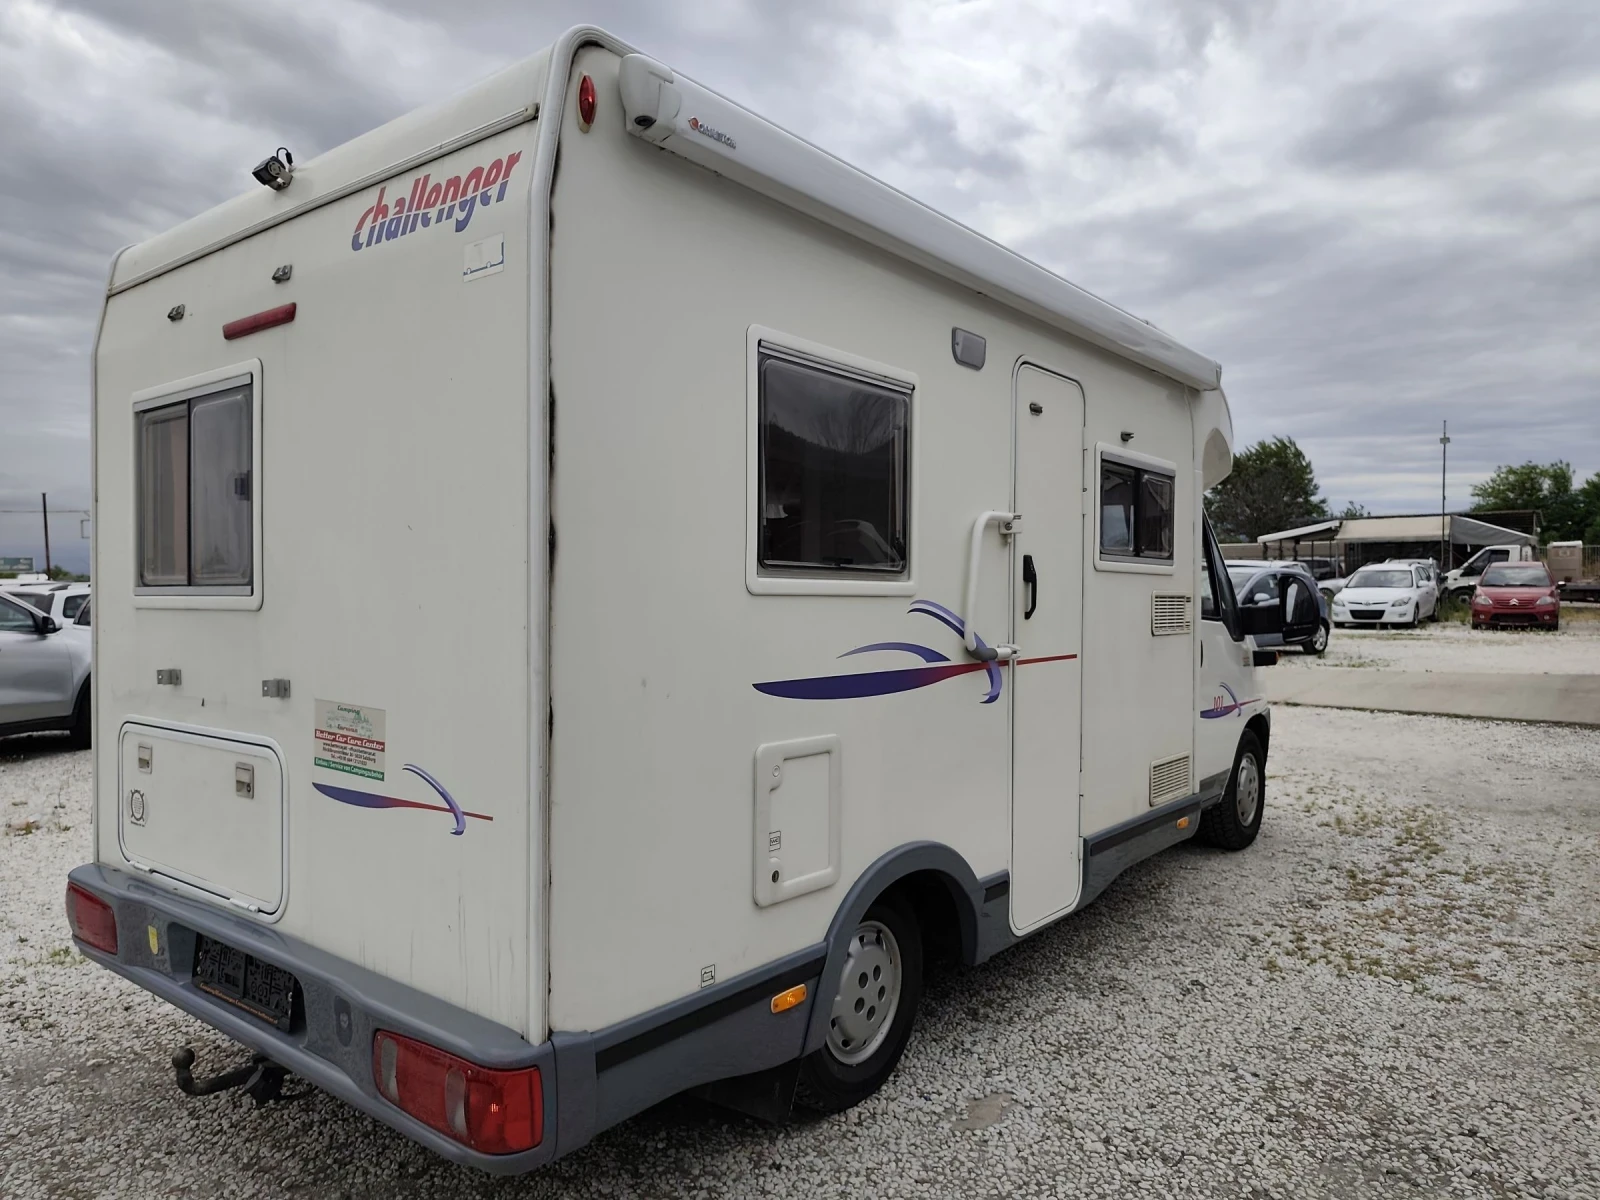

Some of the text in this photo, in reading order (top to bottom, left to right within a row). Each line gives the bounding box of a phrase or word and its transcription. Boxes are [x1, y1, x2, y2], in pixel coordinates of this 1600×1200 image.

[337, 705, 360, 715] Camping
[316, 730, 384, 750] Better Car Care Center
